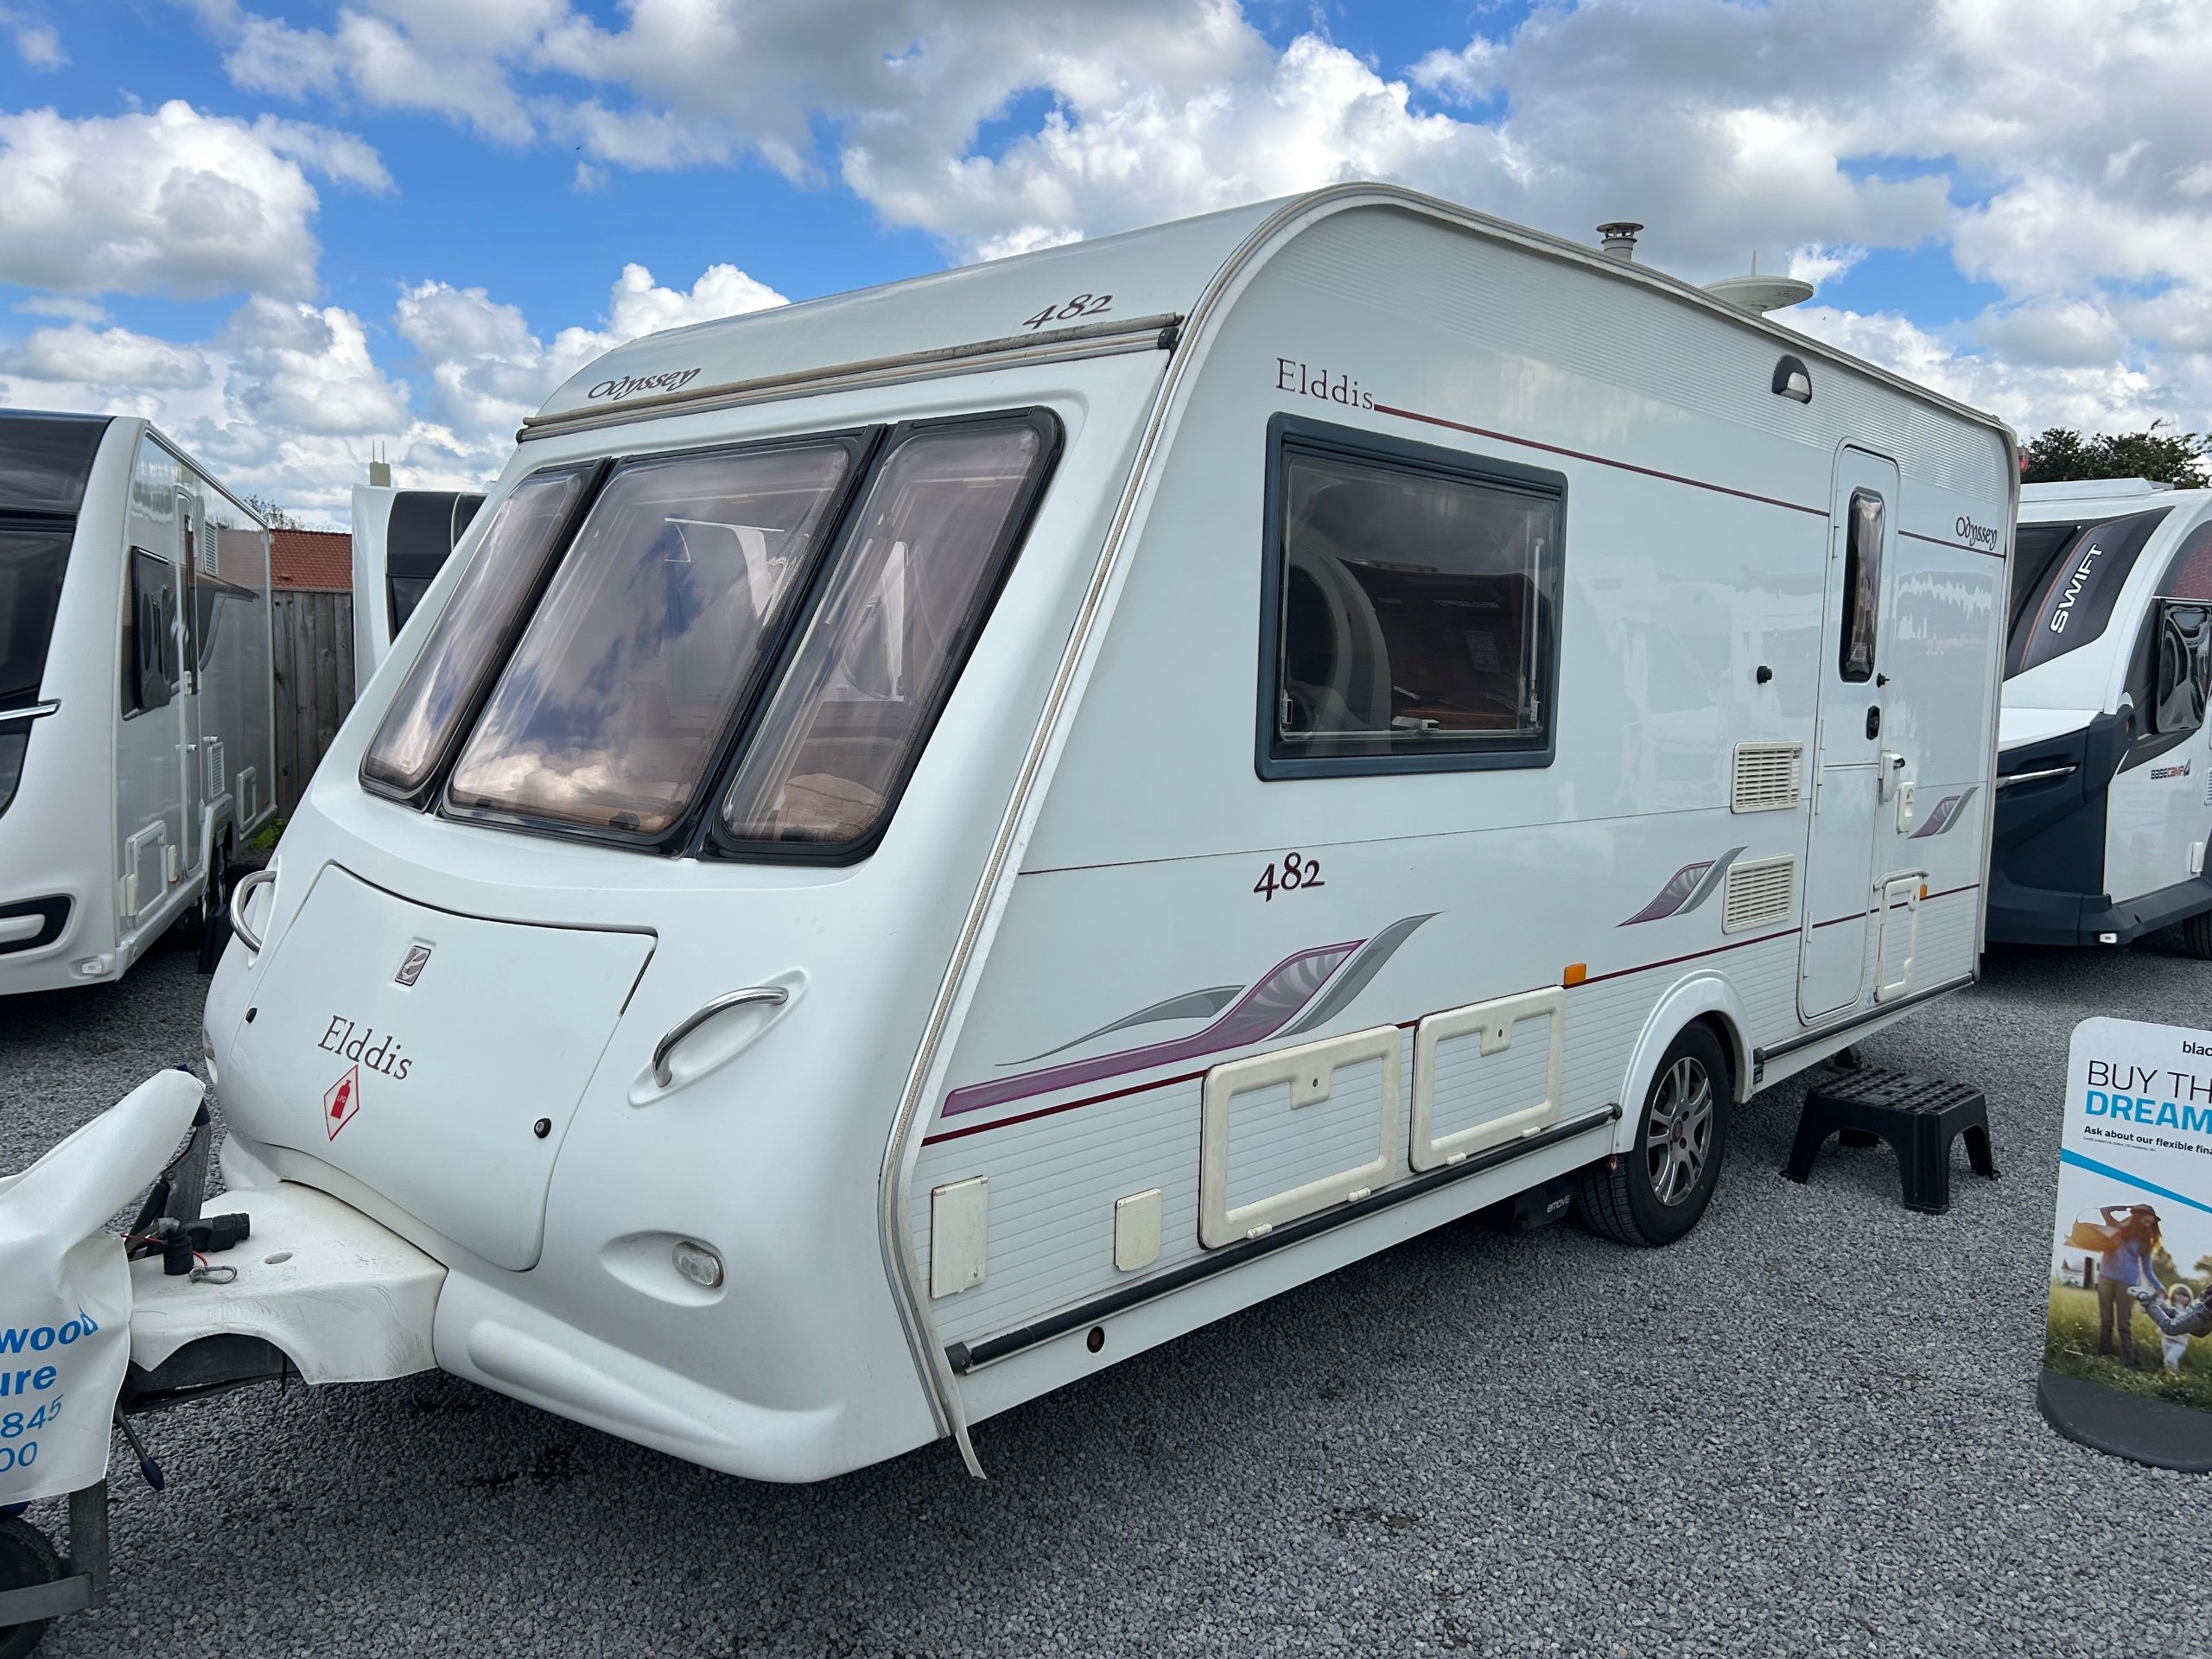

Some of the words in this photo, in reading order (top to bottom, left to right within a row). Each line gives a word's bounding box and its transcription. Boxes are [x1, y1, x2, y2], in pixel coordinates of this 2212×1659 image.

[1022, 294, 1114, 331] 482
[588, 367, 702, 401] Odyssey
[1276, 357, 1373, 410] Elddis
[1955, 516, 1997, 551] Odyssey
[2050, 543, 2102, 633] SWIFT
[1254, 851, 1325, 903] 482
[318, 1014, 413, 1080] Elddis
[2088, 1059, 2158, 1094] BUY
[2167, 1071, 2212, 1104] TH
[2085, 1090, 2212, 1135] DREAM
[2084, 1125, 2103, 1136] Ask
[2105, 1129, 2134, 1141] about
[2136, 1135, 2154, 1145] our
[2156, 1137, 2194, 1152] flexible
[0, 1393, 65, 1439] 845
